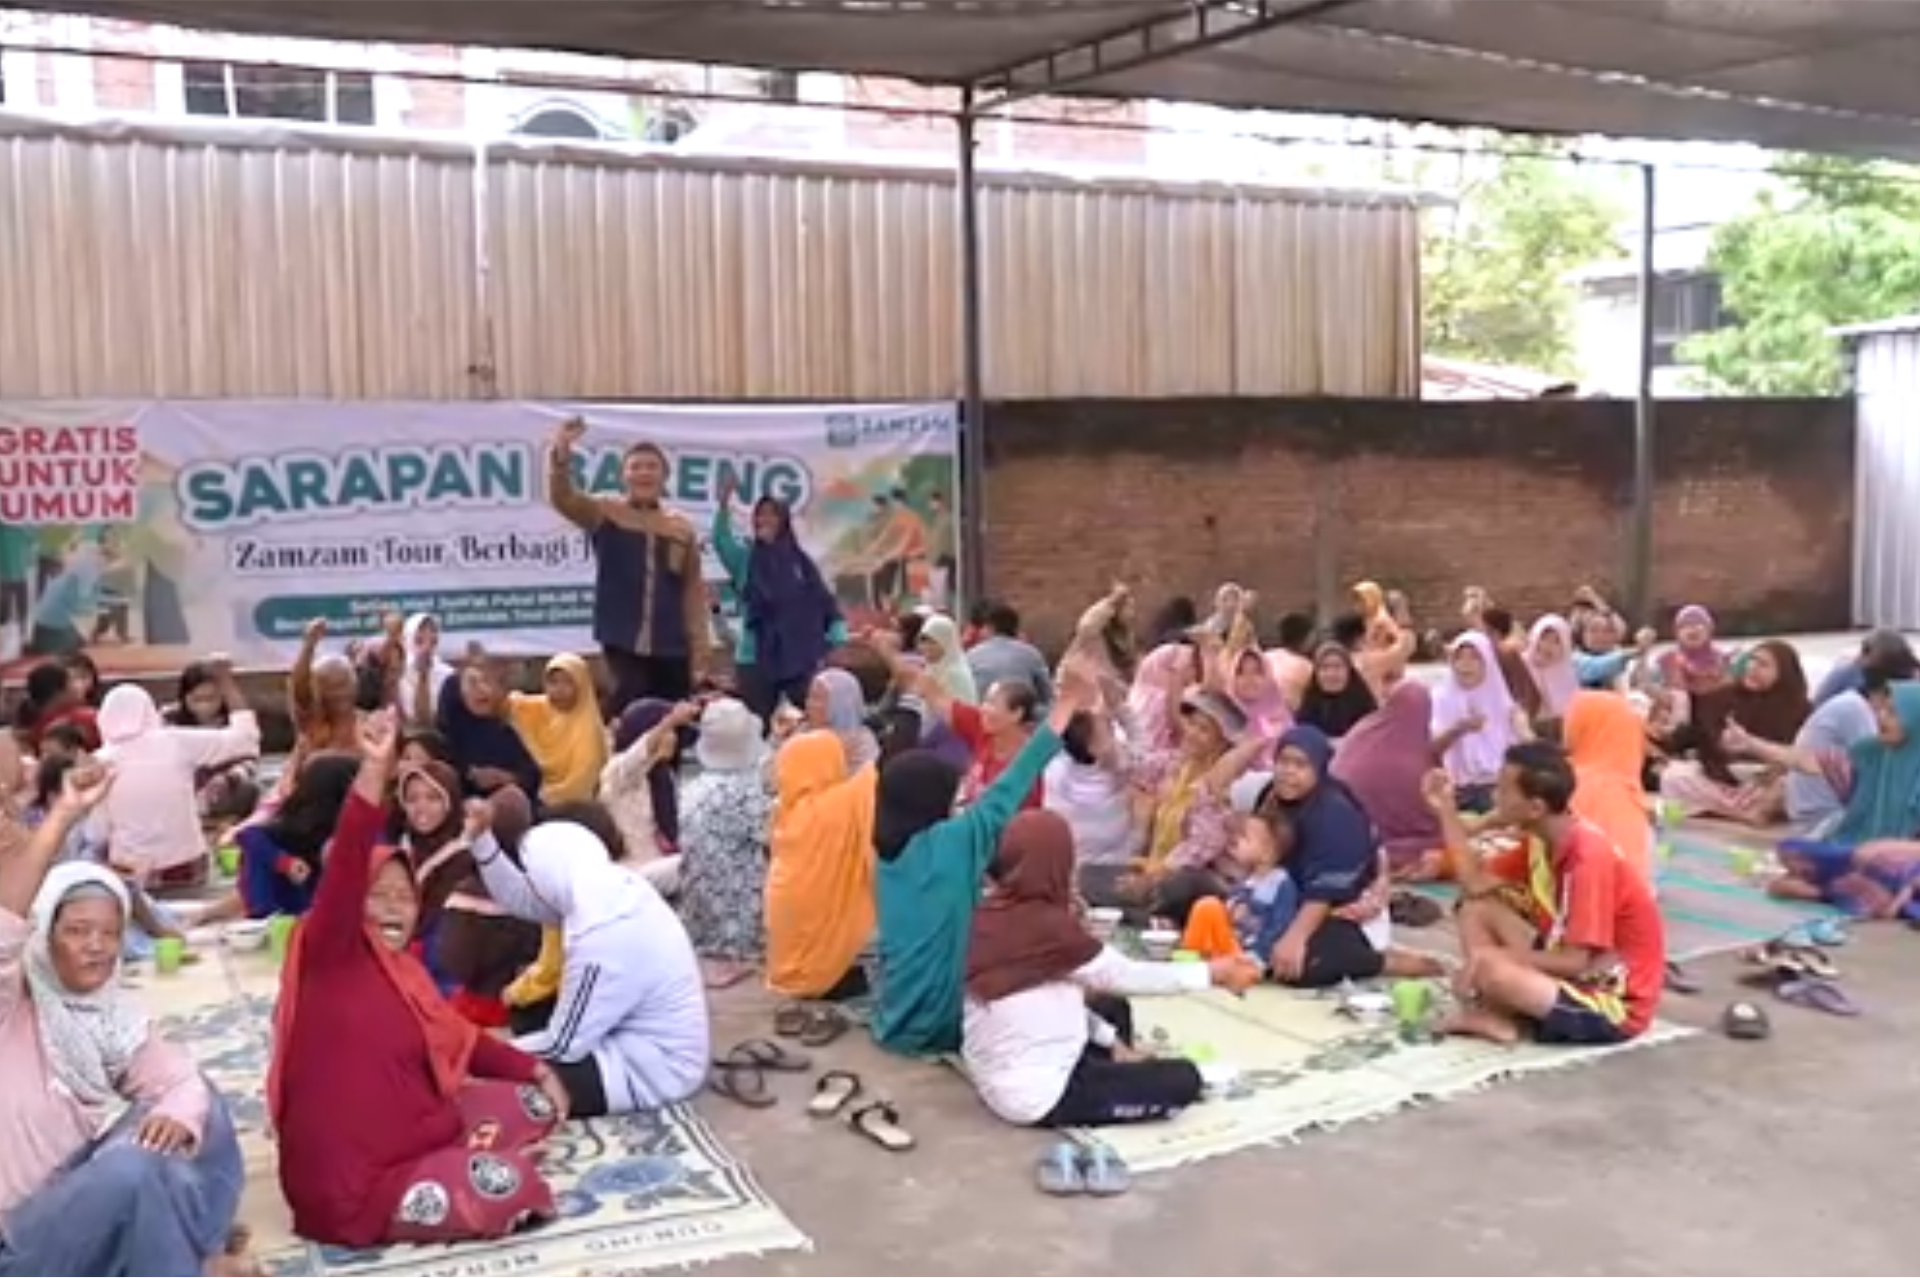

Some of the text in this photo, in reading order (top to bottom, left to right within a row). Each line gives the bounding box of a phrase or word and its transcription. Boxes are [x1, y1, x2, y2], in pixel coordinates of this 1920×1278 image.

[0, 426, 137, 455] GRATIS
[0, 458, 137, 486] UNTUK
[187, 449, 523, 522] SARAPAN
[0, 490, 133, 520] UMUM
[235, 542, 369, 569] Zamzam
[377, 537, 445, 564] Tour
[455, 533, 569, 564] Berbagi
